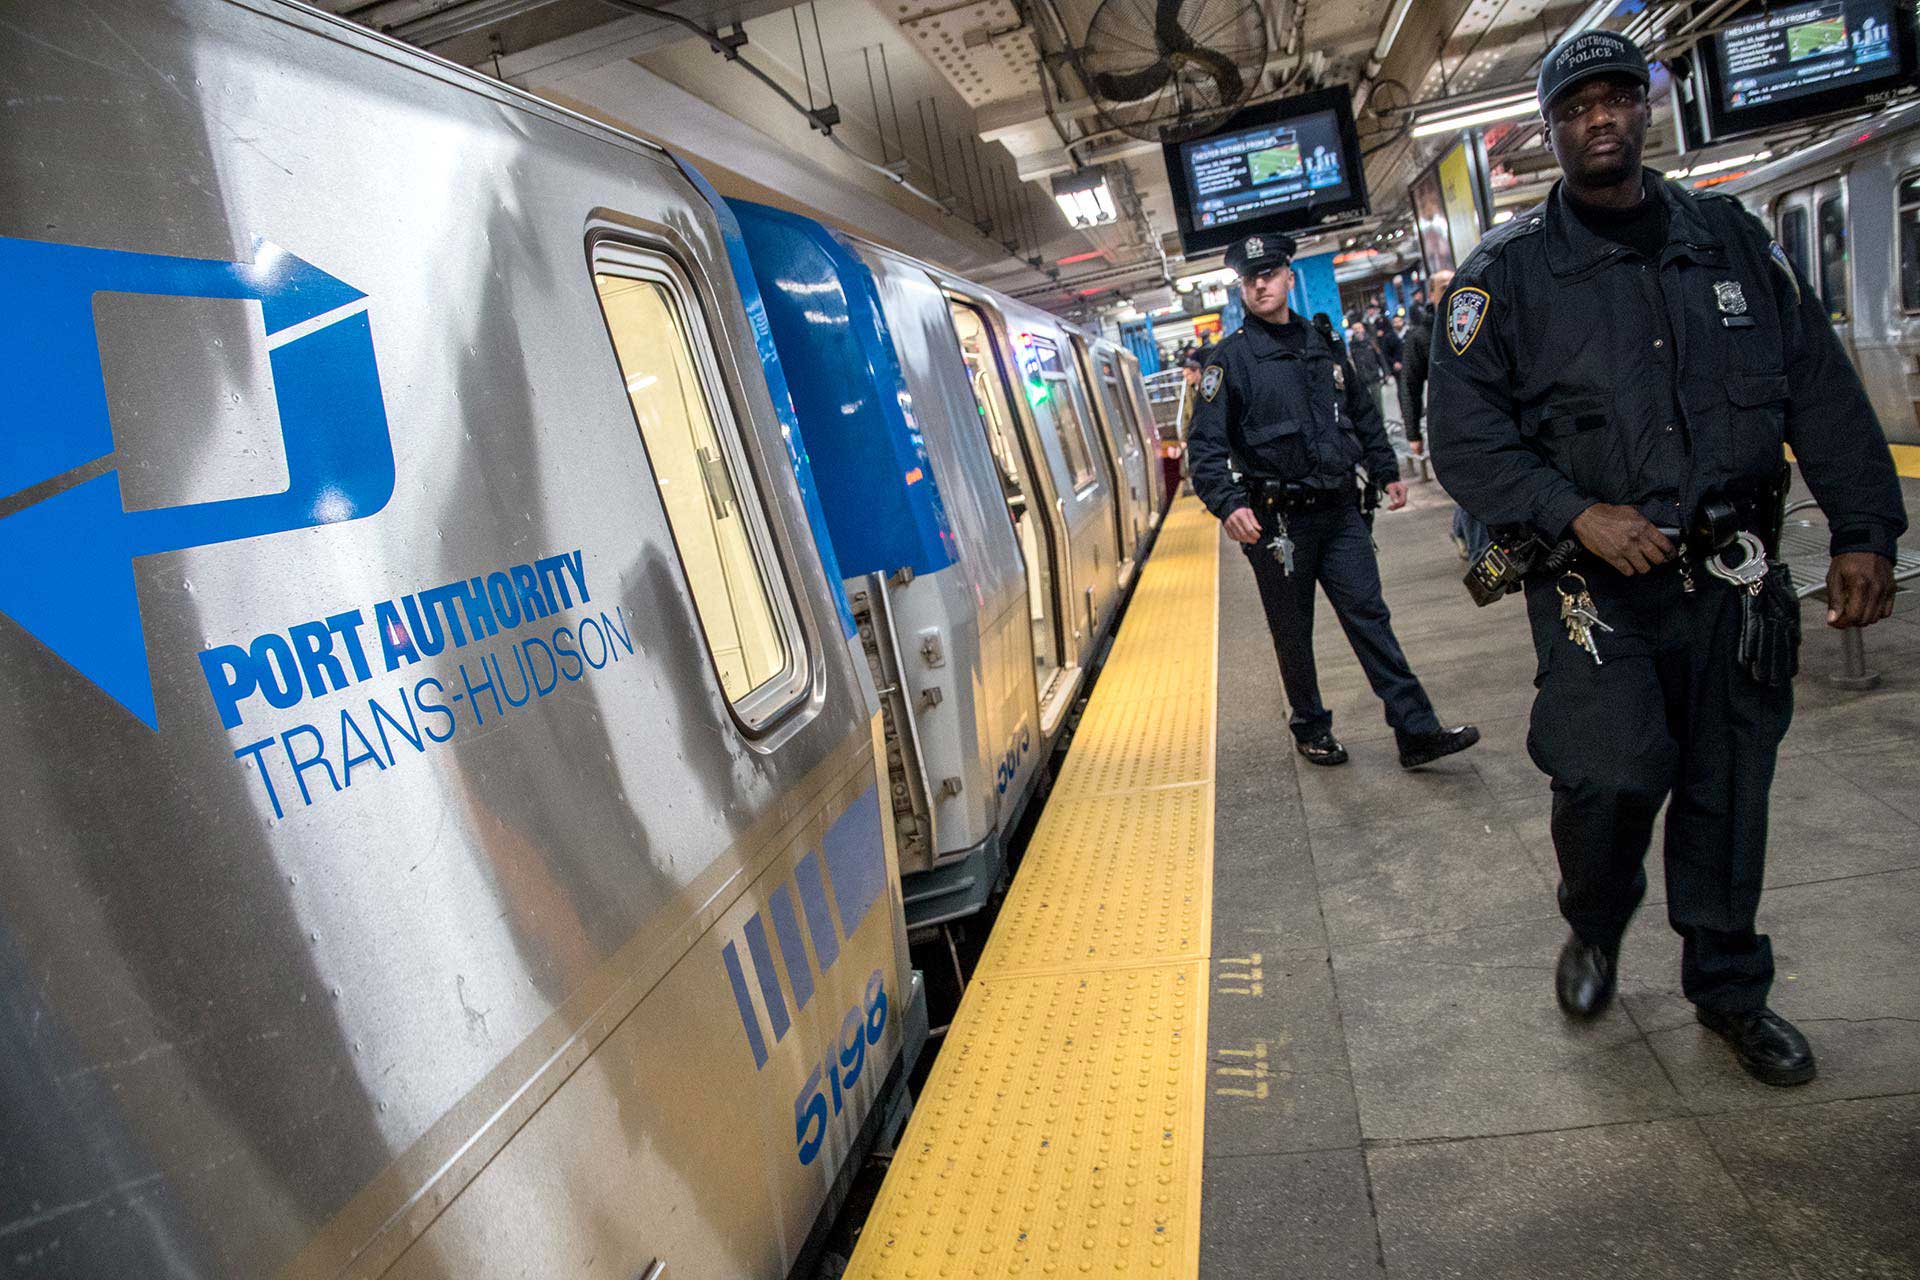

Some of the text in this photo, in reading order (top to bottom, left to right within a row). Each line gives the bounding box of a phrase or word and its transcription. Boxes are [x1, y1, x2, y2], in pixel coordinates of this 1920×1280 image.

[1556, 35, 1625, 70] PORT AUTHORITY
[1569, 47, 1612, 67] POLICE
[1864, 90, 1889, 104] TRACK
[1453, 298, 1482, 310] POLICE
[197, 549, 591, 730] PORT AUTHORITY
[234, 606, 635, 820] TRANS-HUDSON
[795, 968, 888, 1166] 5198
